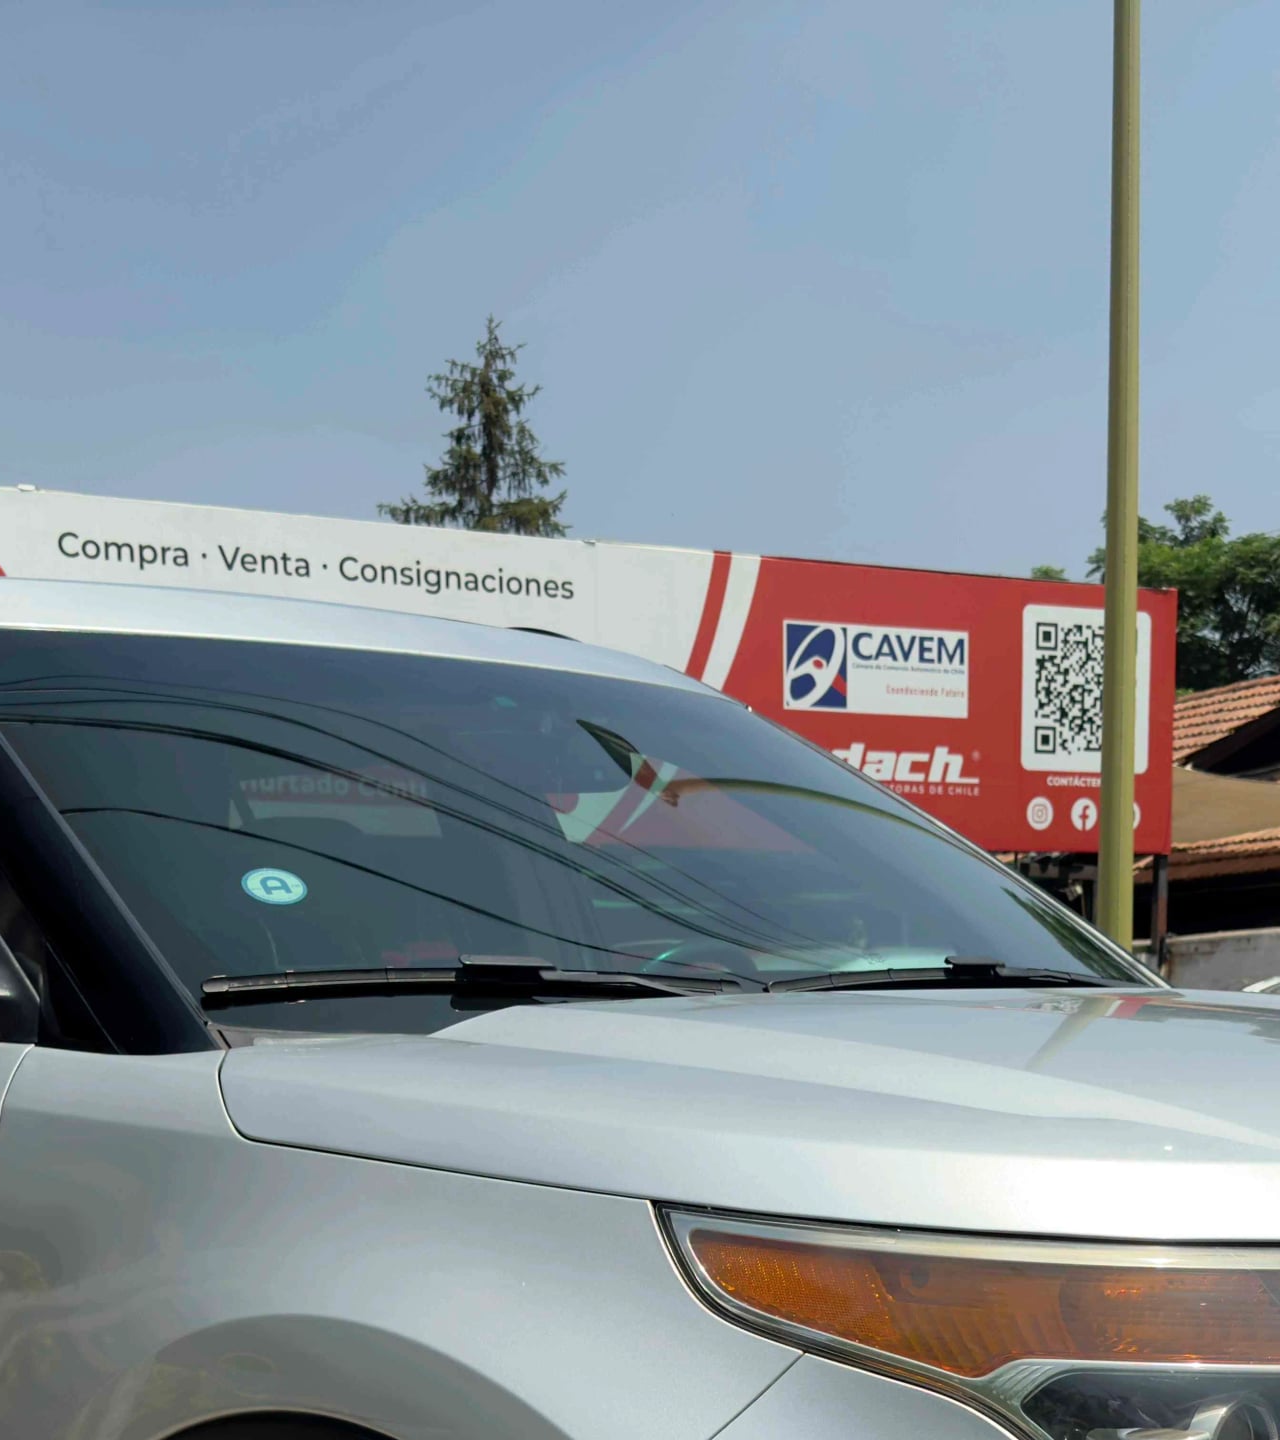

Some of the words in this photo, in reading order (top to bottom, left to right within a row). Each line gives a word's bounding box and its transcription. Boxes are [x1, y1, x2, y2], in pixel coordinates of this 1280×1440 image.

[57, 532, 189, 571] Compra
[218, 544, 311, 579] Venta
[338, 556, 575, 600] Consignaciones
[851, 632, 965, 666] CAVEM
[948, 786, 980, 796] CHILE
